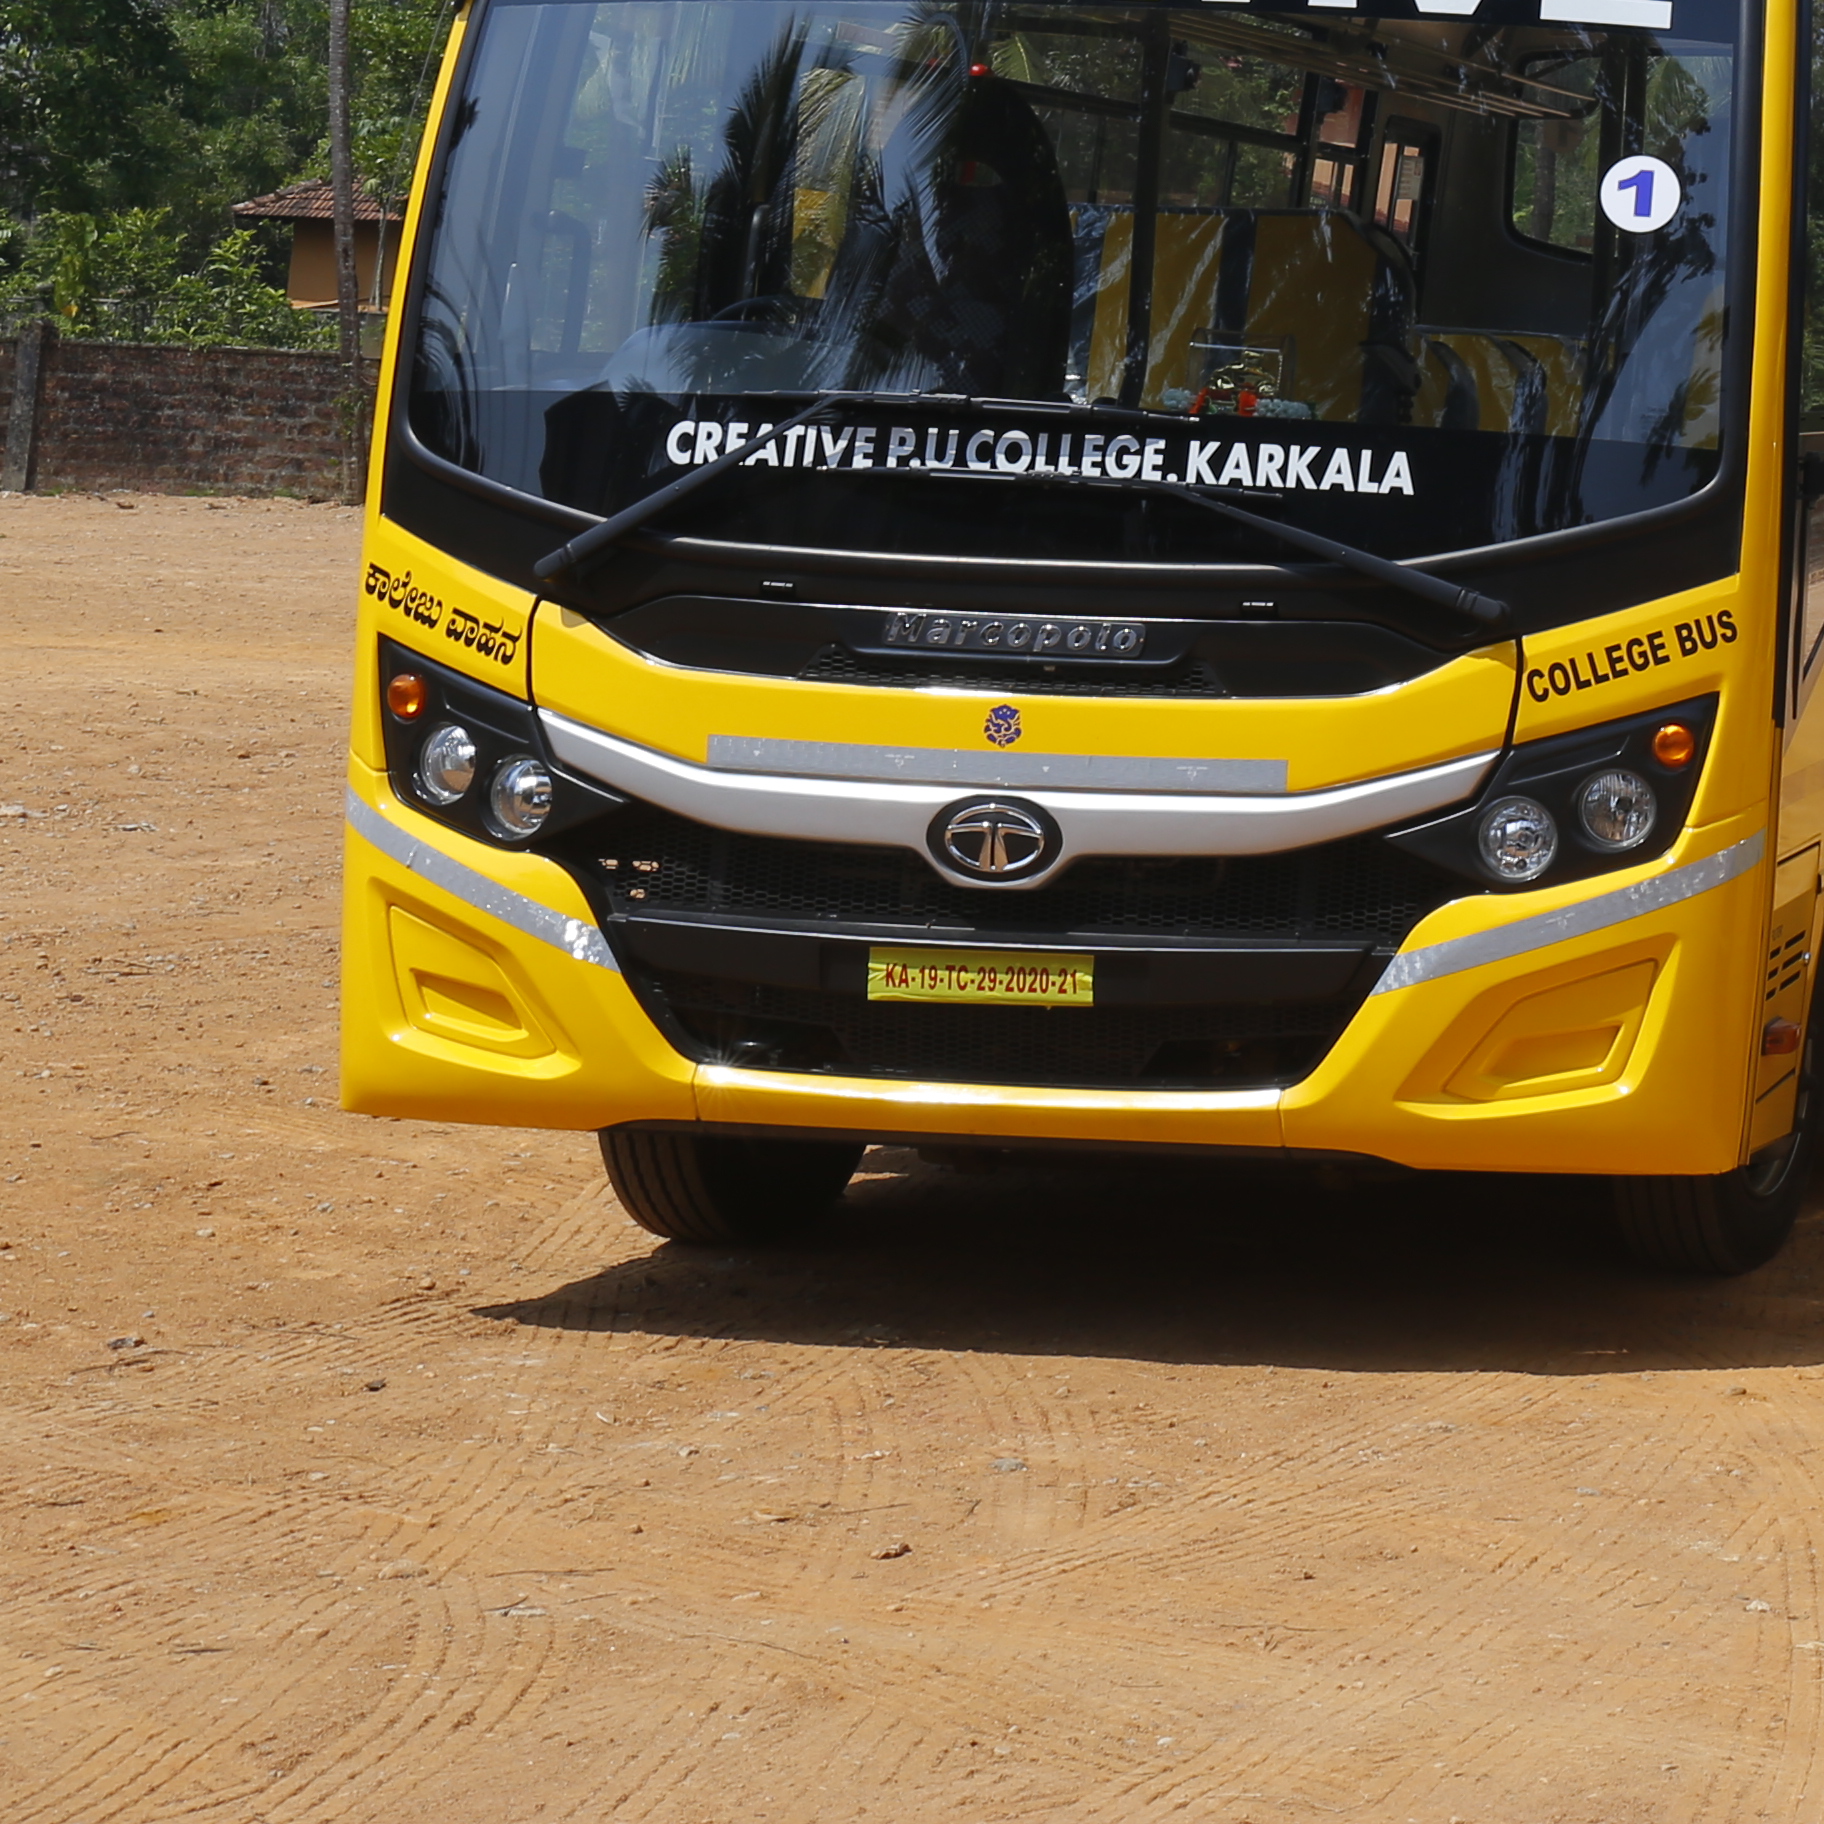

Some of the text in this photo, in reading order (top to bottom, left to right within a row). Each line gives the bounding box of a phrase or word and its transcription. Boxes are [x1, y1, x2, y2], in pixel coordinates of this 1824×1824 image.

[1617, 168, 1655, 218] 1
[666, 419, 877, 470] CREATIVE
[888, 427, 960, 470] P.U
[1185, 440, 1415, 496] KARKALA
[365, 562, 523, 666] ಕಾಲೇಜು ವಾಹನ
[887, 612, 1138, 653] Marcopolo
[1526, 609, 1738, 703] COLLEGE BUS
[884, 962, 1079, 995] KA-19-TC-29-2020-21
